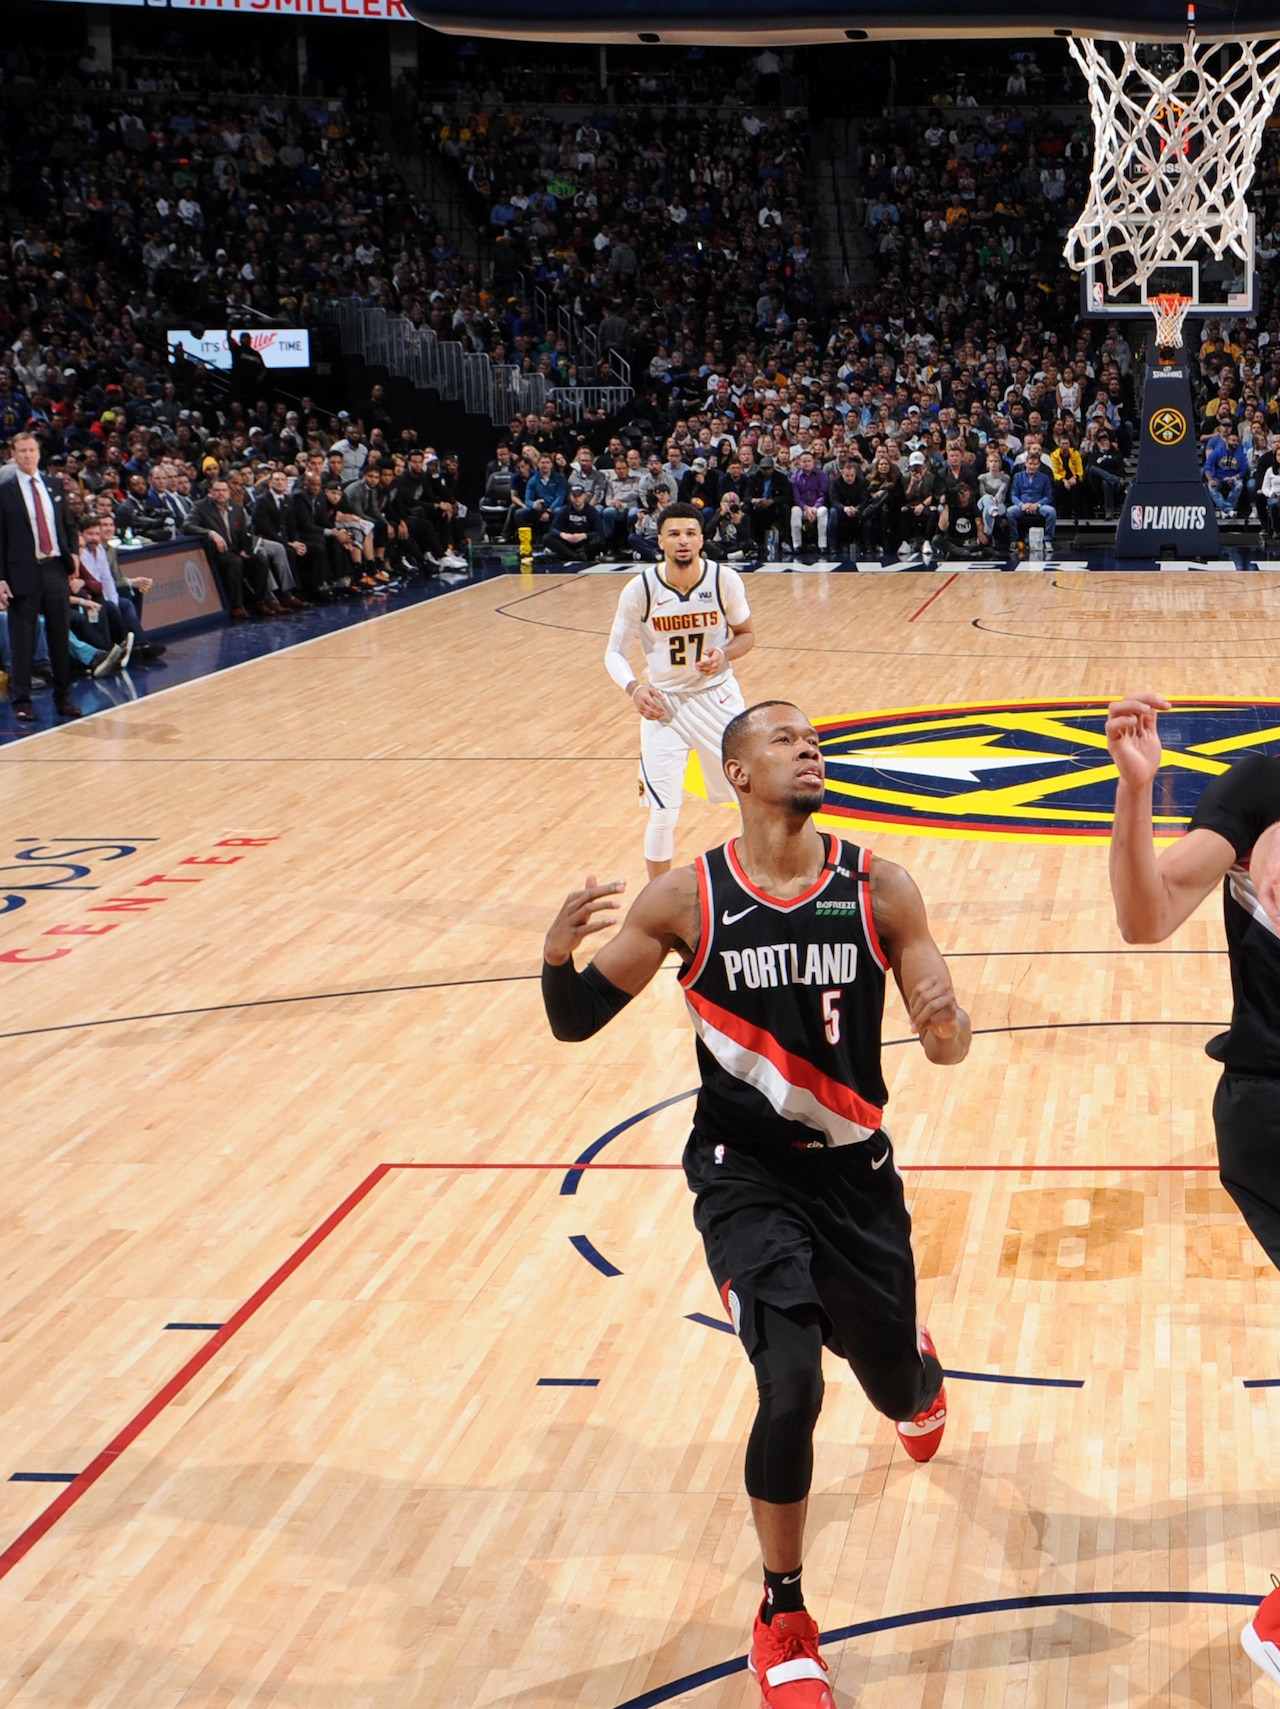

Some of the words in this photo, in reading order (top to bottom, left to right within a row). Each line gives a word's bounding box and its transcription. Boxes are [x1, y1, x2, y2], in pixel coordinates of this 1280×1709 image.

[201, 342, 219, 353] IT'S
[279, 341, 302, 352] TIME
[1143, 505, 1206, 530] PLAYOFFS
[651, 610, 719, 632] NUGGETS
[669, 632, 706, 667] 27
[0, 836, 281, 963] CENTER
[719, 943, 858, 991] PORTLAND
[821, 989, 843, 1045] 5
